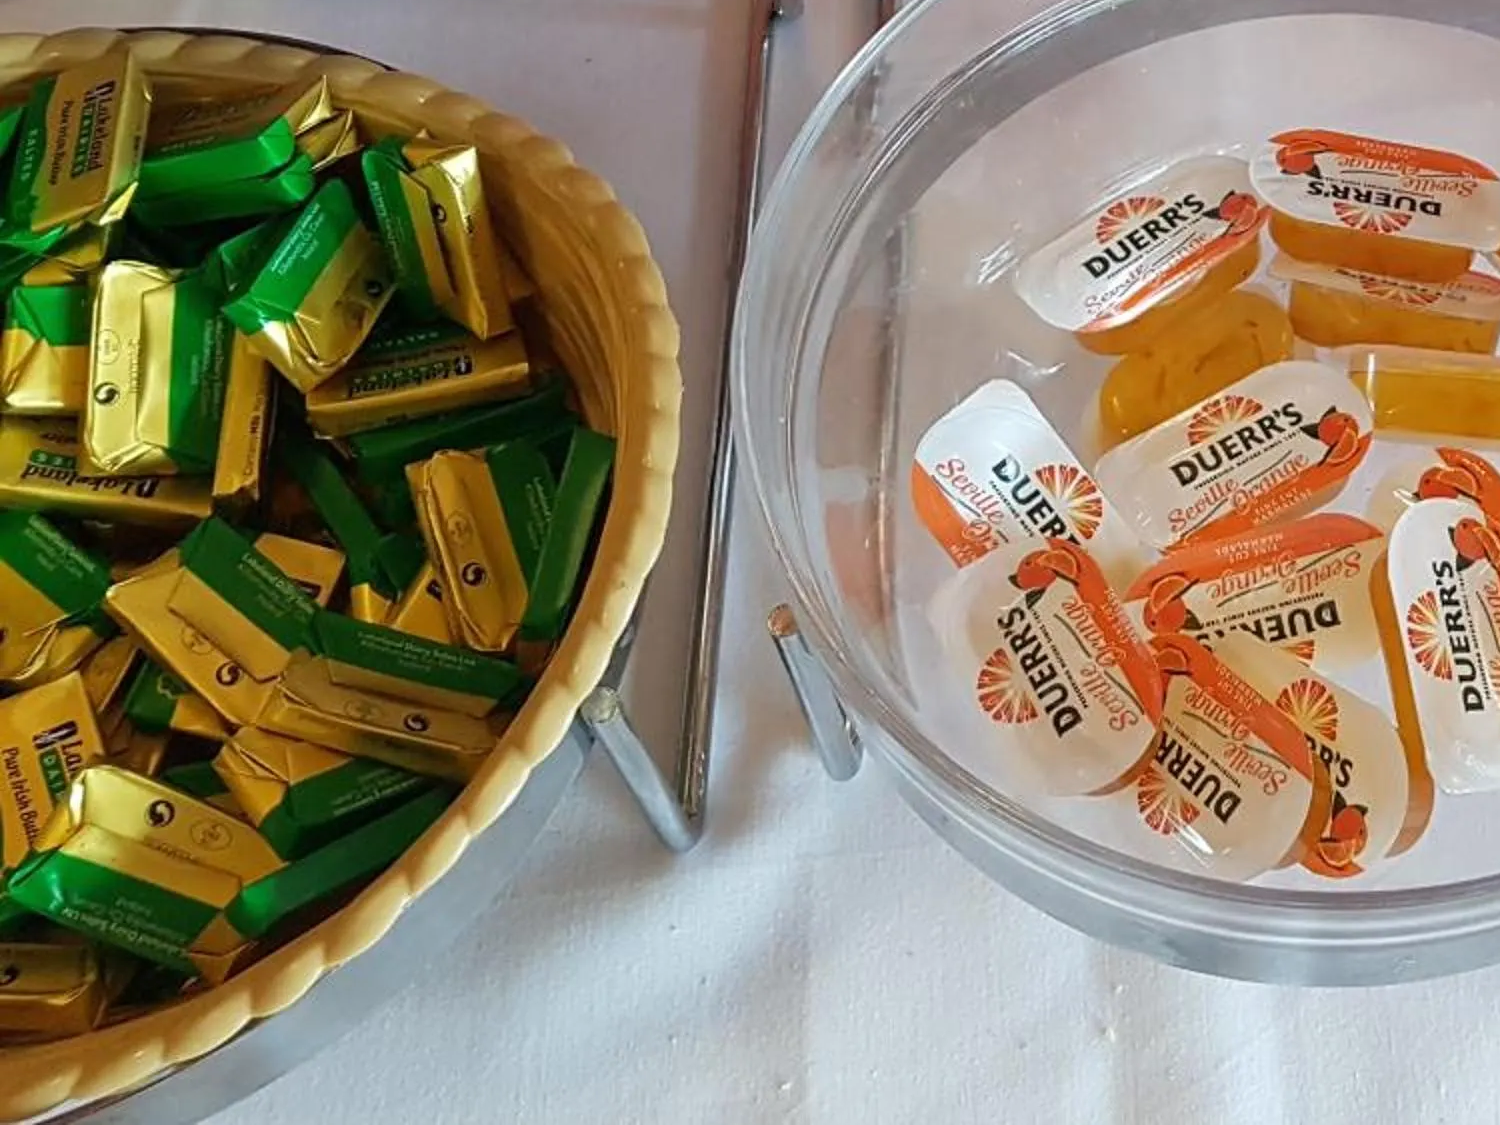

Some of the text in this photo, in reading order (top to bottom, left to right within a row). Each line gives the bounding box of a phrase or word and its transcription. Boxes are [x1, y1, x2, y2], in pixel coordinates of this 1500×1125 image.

[1306, 179, 1443, 217] DUERR'S
[1082, 193, 1205, 279] DUERR'S
[1169, 401, 1304, 488] DUERR'S
[935, 458, 1006, 525] Seville
[992, 454, 1081, 546] DUER
[1167, 478, 1239, 532] Seville
[1232, 453, 1309, 516] Orange
[1206, 550, 1297, 600] Orange
[1281, 550, 1361, 595] Seville
[1061, 594, 1127, 667] Orange
[1432, 560, 1485, 713] DUERR'S
[997, 606, 1084, 739] DUERR'S
[1080, 662, 1139, 732] Seville
[1184, 684, 1252, 741] Orange
[2, 746, 40, 851] Pure Irish Butt
[1154, 729, 1243, 825] DUERR
[1221, 739, 1288, 796] Seville
